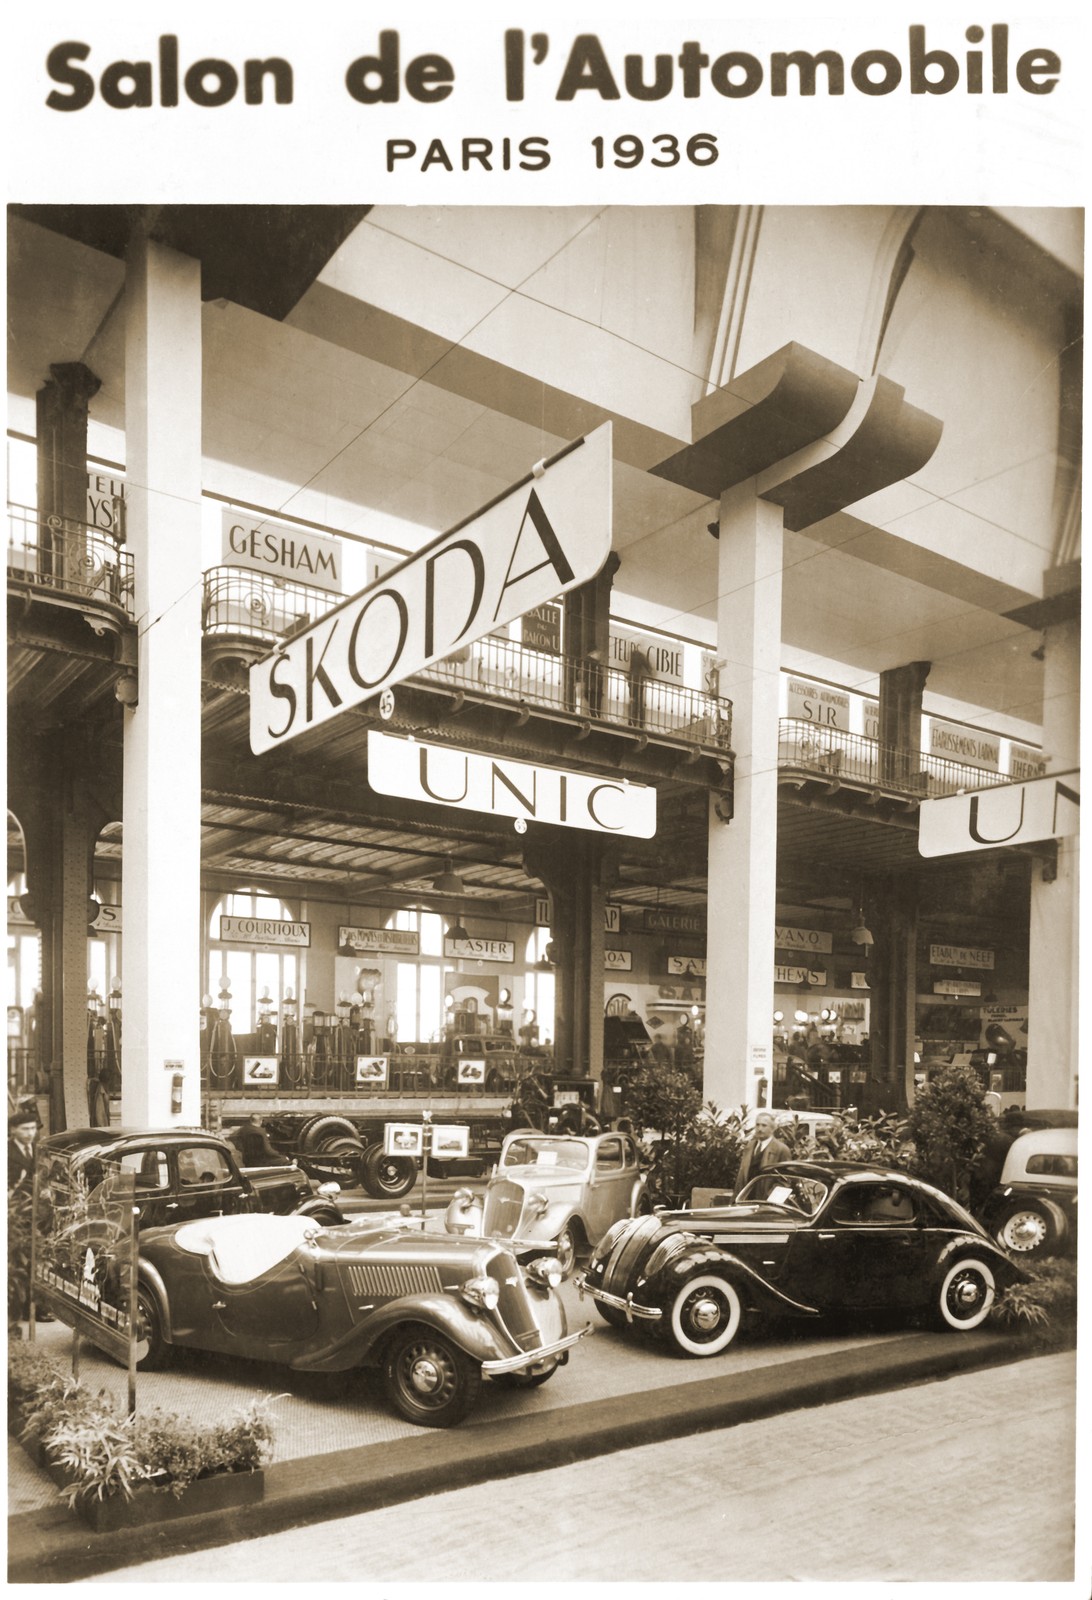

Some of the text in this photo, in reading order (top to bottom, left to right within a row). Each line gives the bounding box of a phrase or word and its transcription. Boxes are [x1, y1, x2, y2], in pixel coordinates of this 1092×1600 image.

[229, 524, 338, 581] GESHAM
[267, 486, 576, 739] SKODA
[419, 747, 625, 831] UNIC
[604, 951, 626, 964] OA
